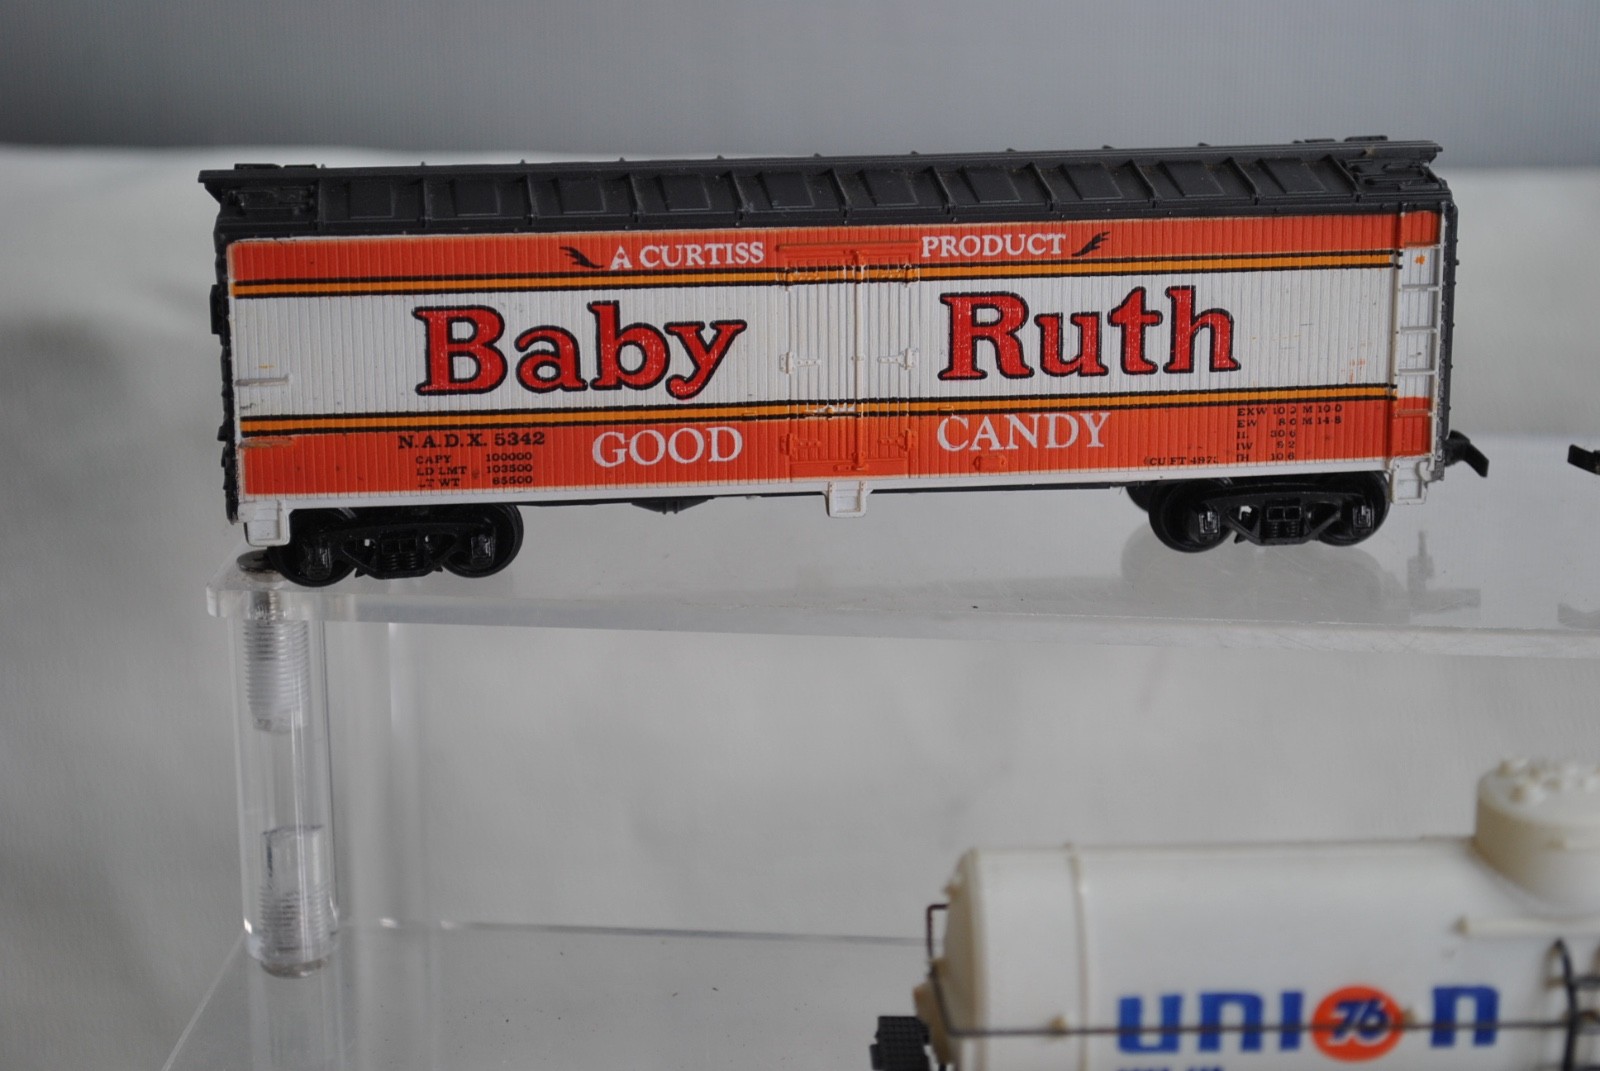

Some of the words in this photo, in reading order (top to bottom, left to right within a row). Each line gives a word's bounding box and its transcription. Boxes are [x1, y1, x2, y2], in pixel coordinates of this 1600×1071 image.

[609, 245, 633, 271] A
[639, 241, 765, 268] CURTISS
[921, 233, 1066, 258] PRODUCT
[412, 300, 747, 400] Baby
[937, 285, 1242, 382] Ruth
[1237, 406, 1266, 417] EXW
[1302, 405, 1313, 414] M
[1237, 419, 1257, 429] EW
[1302, 417, 1313, 426] M
[398, 433, 487, 449] N.A.D.X.
[494, 431, 546, 447] 5342
[592, 427, 744, 468] GOOD
[936, 411, 1111, 453] CANDY
[415, 454, 452, 465] CAPY
[486, 451, 533, 462] 100000
[1149, 457, 1166, 467] CU
[1170, 456, 1187, 465] FT
[416, 467, 435, 476] LD
[438, 465, 468, 476] LMT
[486, 464, 533, 474] 103500
[438, 478, 460, 488] WT
